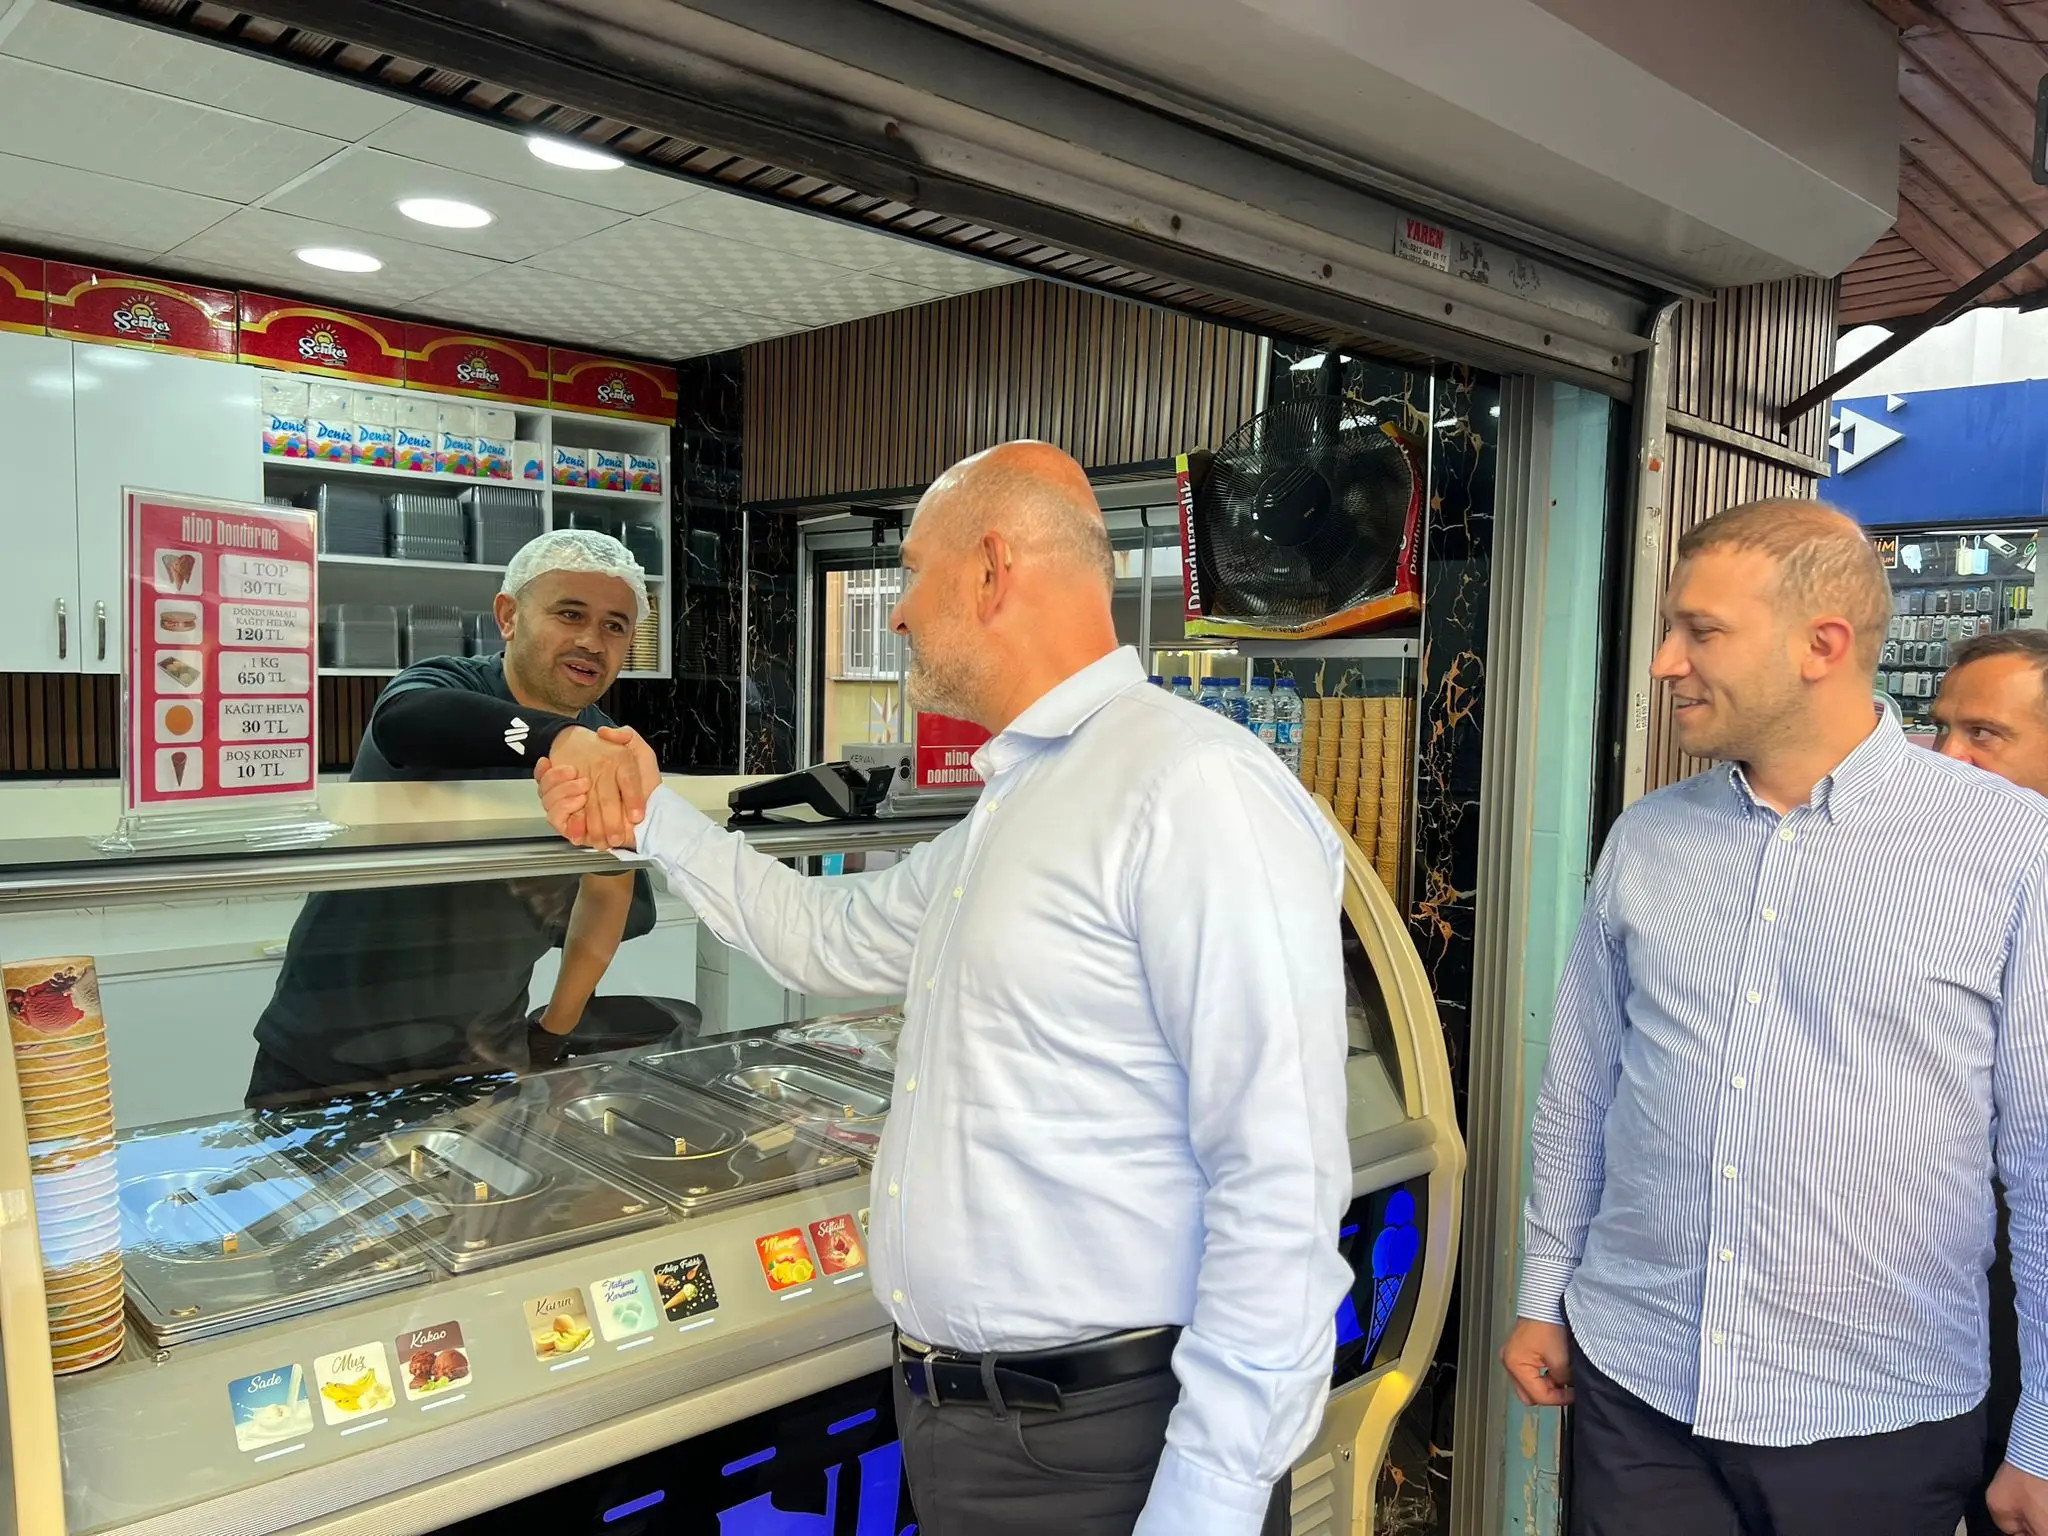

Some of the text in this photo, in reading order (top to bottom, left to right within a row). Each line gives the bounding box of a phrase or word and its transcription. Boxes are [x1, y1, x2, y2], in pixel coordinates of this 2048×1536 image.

[1406, 218, 1444, 249] YAREN
[271, 414, 306, 433] Deniz
[316, 421, 353, 442] Deniz
[358, 425, 392, 442] Deniz
[397, 429, 432, 449] Deniz
[443, 432, 473, 451] Deniz
[478, 438, 506, 456] Deniz
[556, 448, 585, 468] Deniz
[596, 452, 624, 469] Deniz
[629, 454, 657, 470] Deniz
[242, 562, 289, 578] 1 TOP
[243, 580, 287, 596] 30 TL
[233, 607, 297, 619] DONDURMALI
[266, 618, 295, 628] HELVA
[236, 628, 285, 641] 120 TL
[260, 657, 280, 668] KG
[237, 671, 287, 685] 650 TL
[224, 702, 304, 715] KAĞIT HELVA
[242, 719, 289, 734] 30 TL
[226, 748, 305, 762] BOŞ KORNET
[945, 749, 969, 766] NİDO
[237, 763, 285, 778] 10 TL
[605, 1286, 639, 1303] Karamel
[535, 1294, 573, 1316] Kavun
[410, 1329, 447, 1349] Kakao
[331, 1352, 367, 1374] Muz
[247, 1373, 282, 1394] Sade
